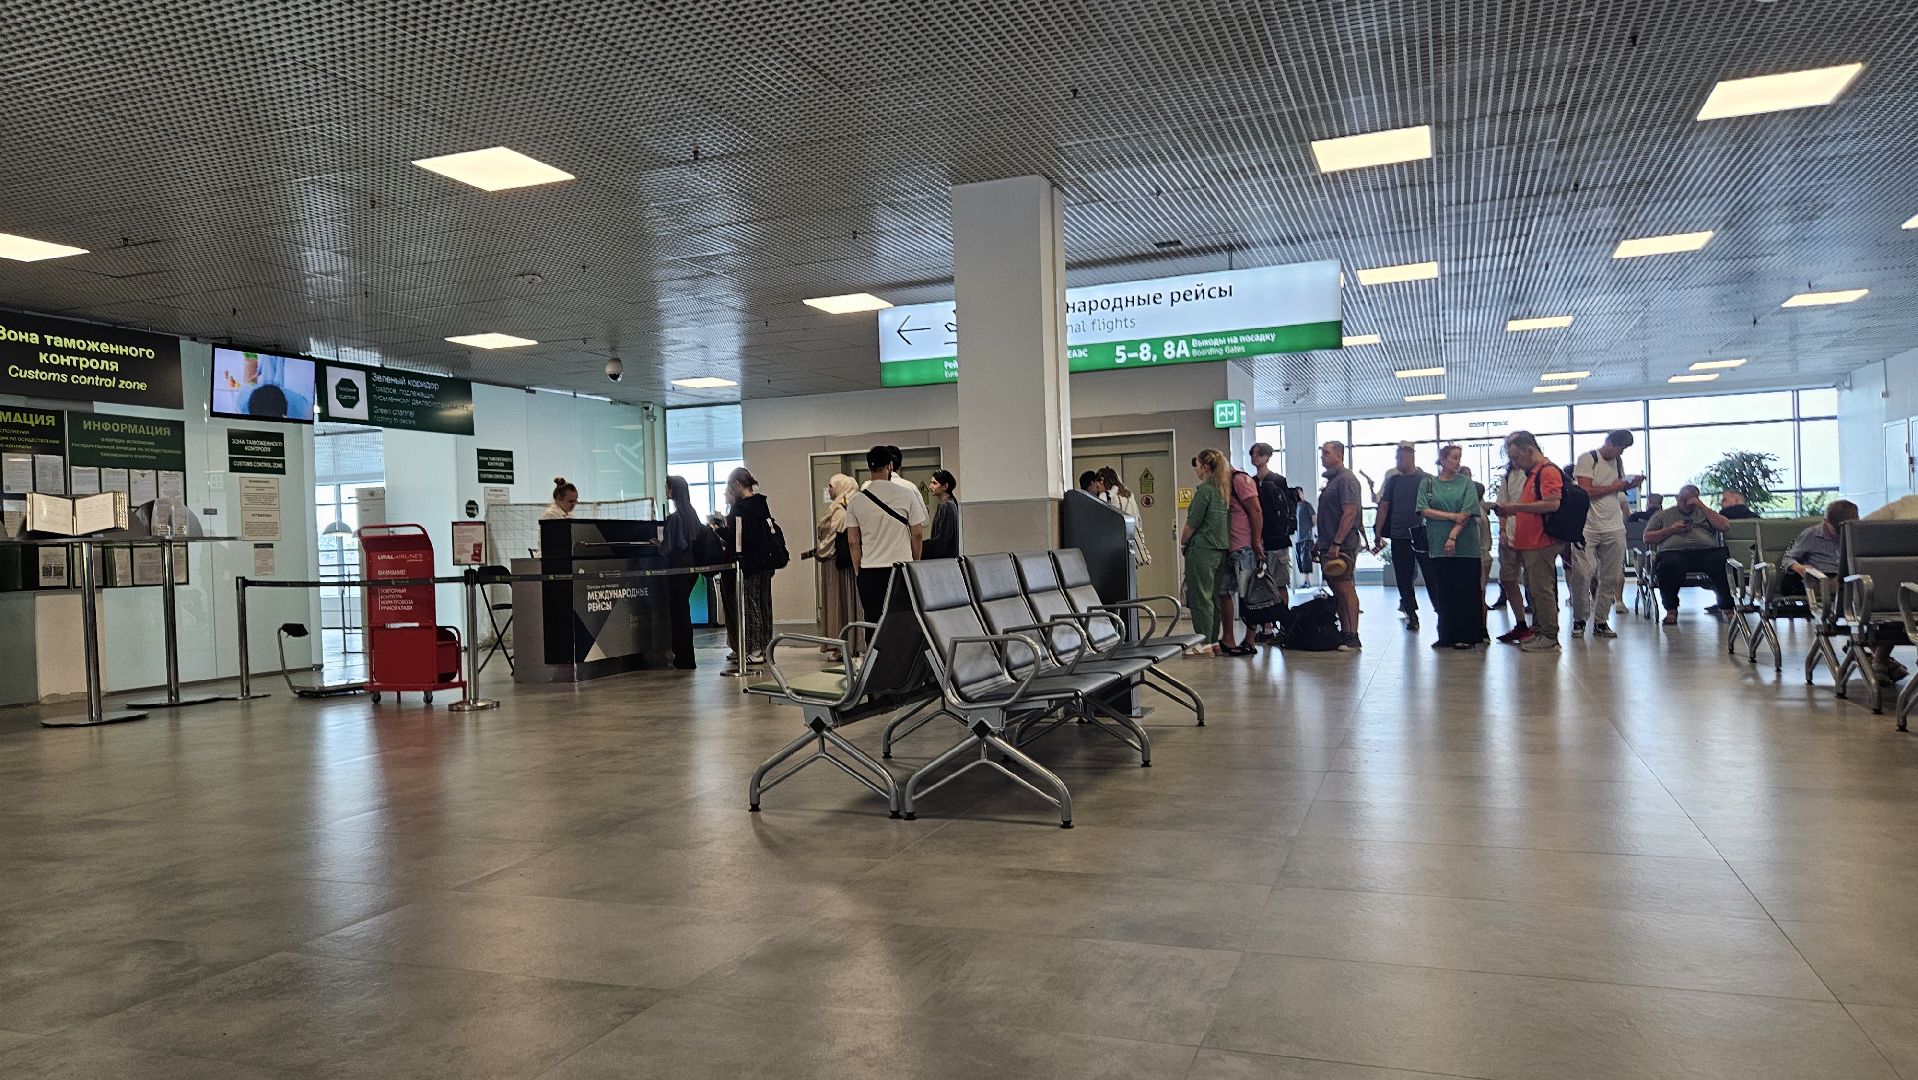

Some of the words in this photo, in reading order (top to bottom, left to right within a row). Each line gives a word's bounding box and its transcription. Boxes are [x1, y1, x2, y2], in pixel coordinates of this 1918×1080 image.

[1066, 291, 1163, 315] народные
[1170, 282, 1233, 306] рейсы
[1091, 317, 1136, 333] flights
[0, 324, 40, 345] Зона
[44, 334, 156, 360] таможенного
[1191, 336, 1226, 347] Выходы
[1226, 335, 1239, 345] на
[1239, 332, 1276, 343] посадку
[1191, 346, 1224, 357] Boarding
[1224, 344, 1246, 354] Gates
[39, 351, 119, 372] контроля
[8, 364, 68, 383] Customs
[71, 374, 116, 388] control
[118, 379, 148, 391] zone
[407, 379, 440, 391] коридор
[0, 411, 56, 427] МАЦИЯ
[83, 420, 171, 437] ИНФОРМАЦИЯ
[587, 587, 649, 601] МЕЖДУНАРОДНЫЕ
[587, 600, 613, 613] РЕЙСЫ
